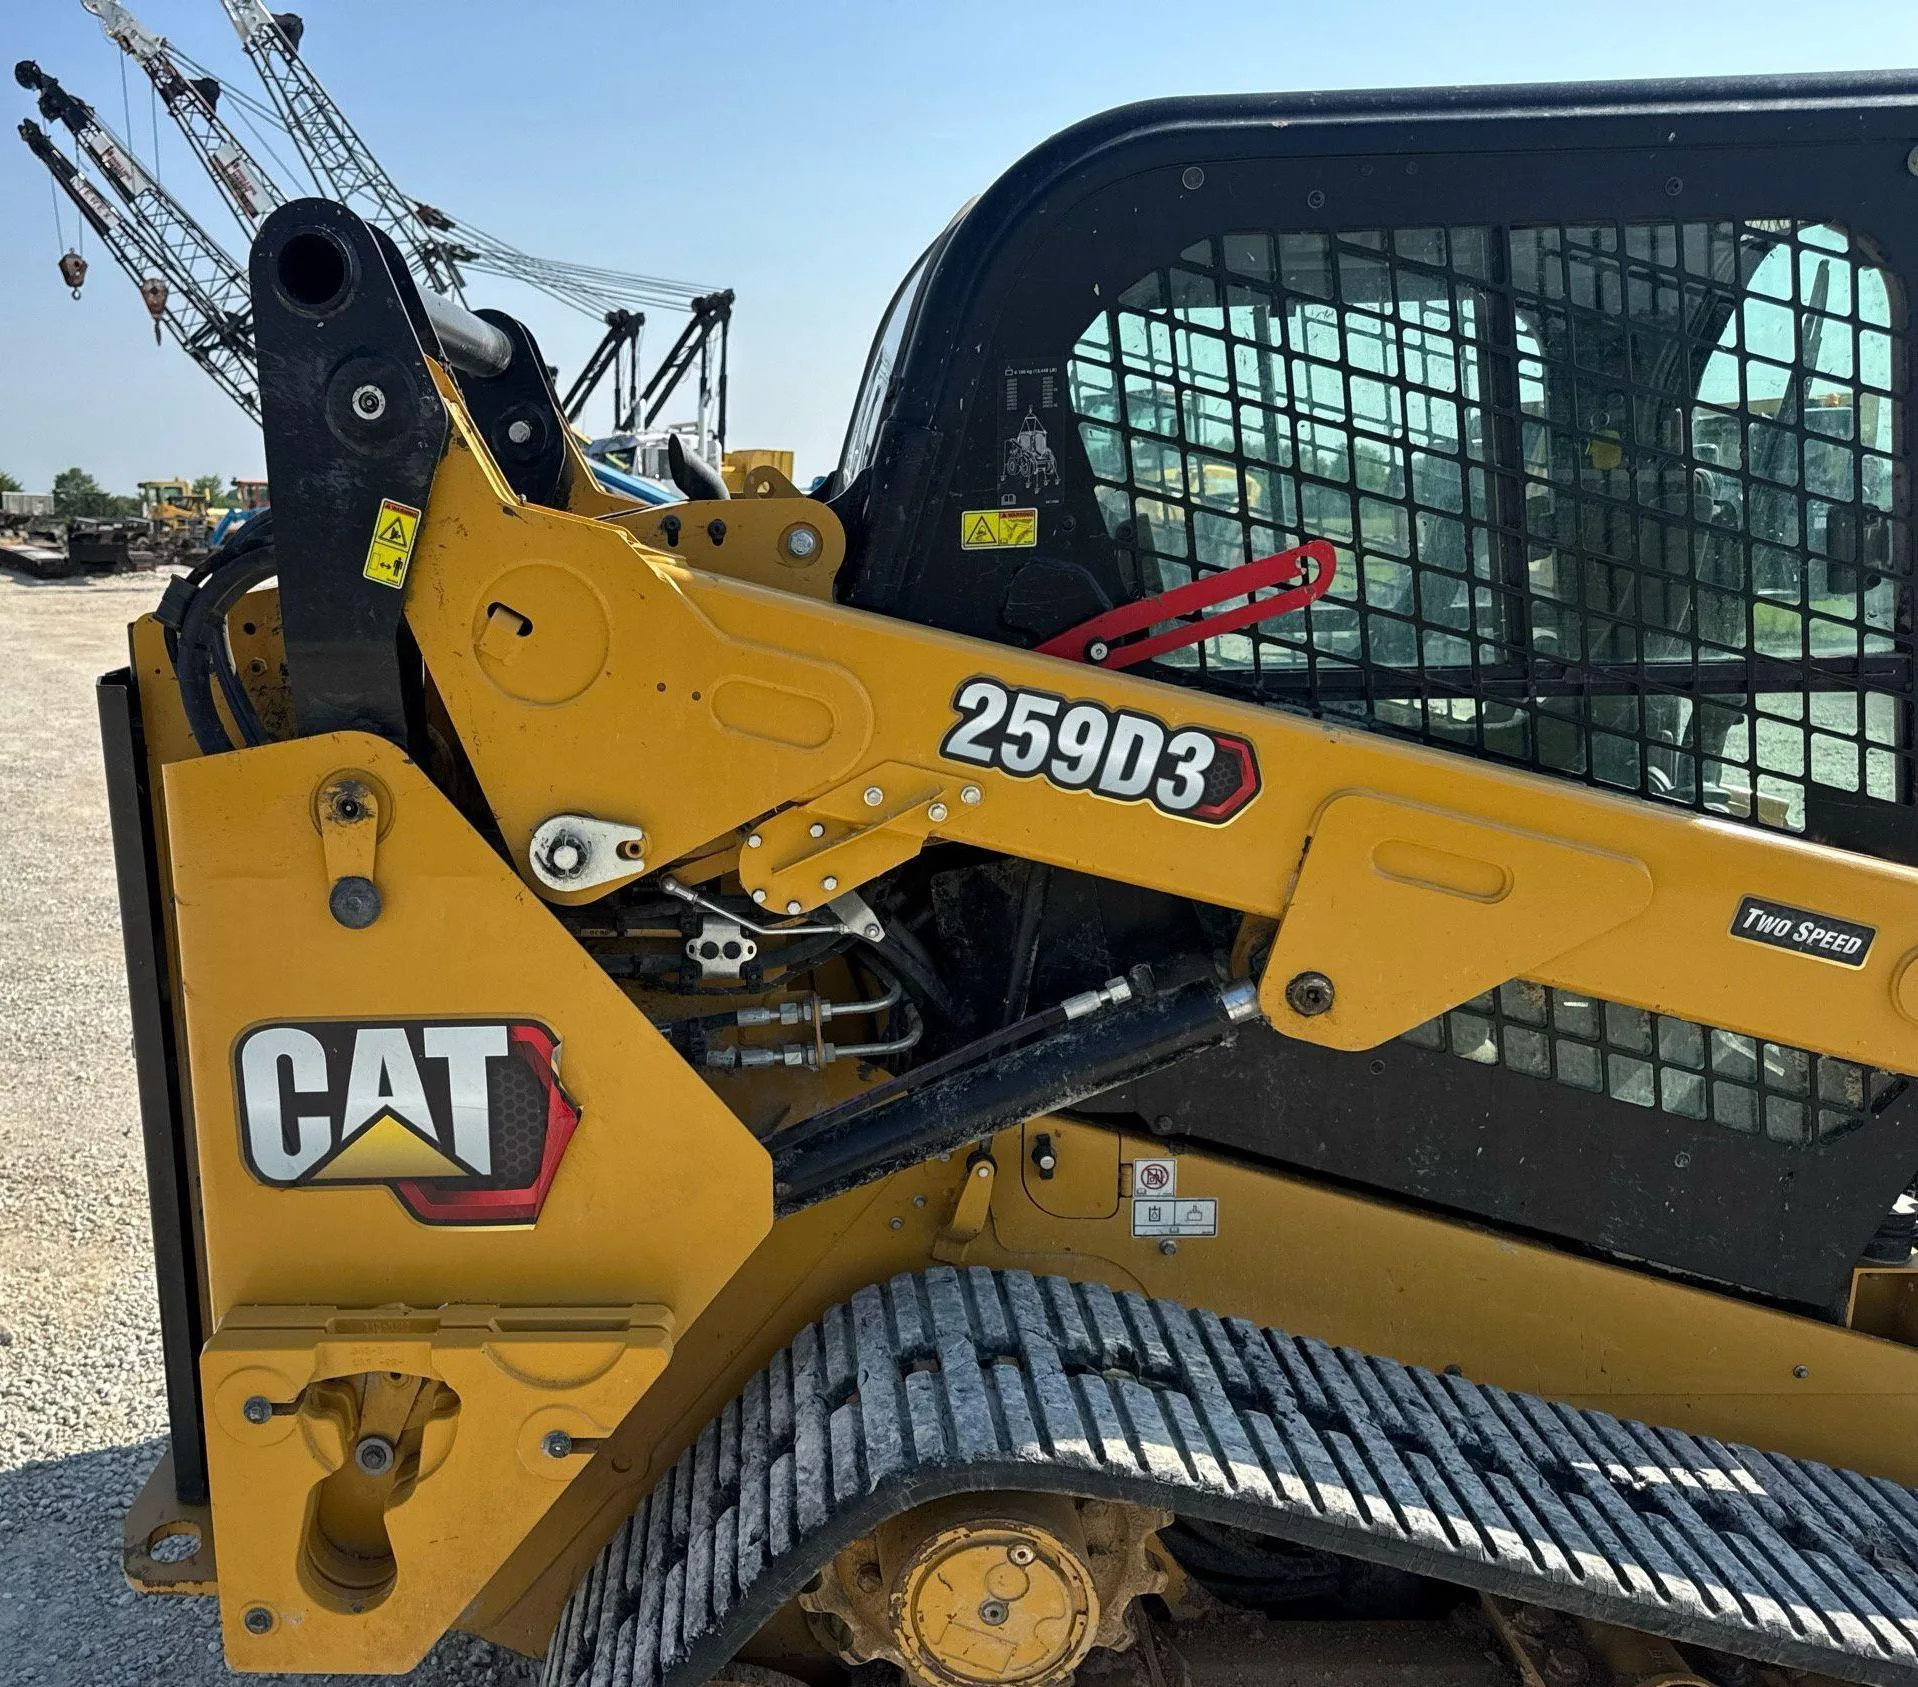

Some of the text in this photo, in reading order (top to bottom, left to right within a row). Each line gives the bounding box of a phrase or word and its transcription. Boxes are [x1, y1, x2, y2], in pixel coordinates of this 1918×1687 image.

[946, 683, 1215, 810] 259D3
[1743, 908, 1862, 954] TWO SPEED
[242, 1026, 508, 1180] CAT
